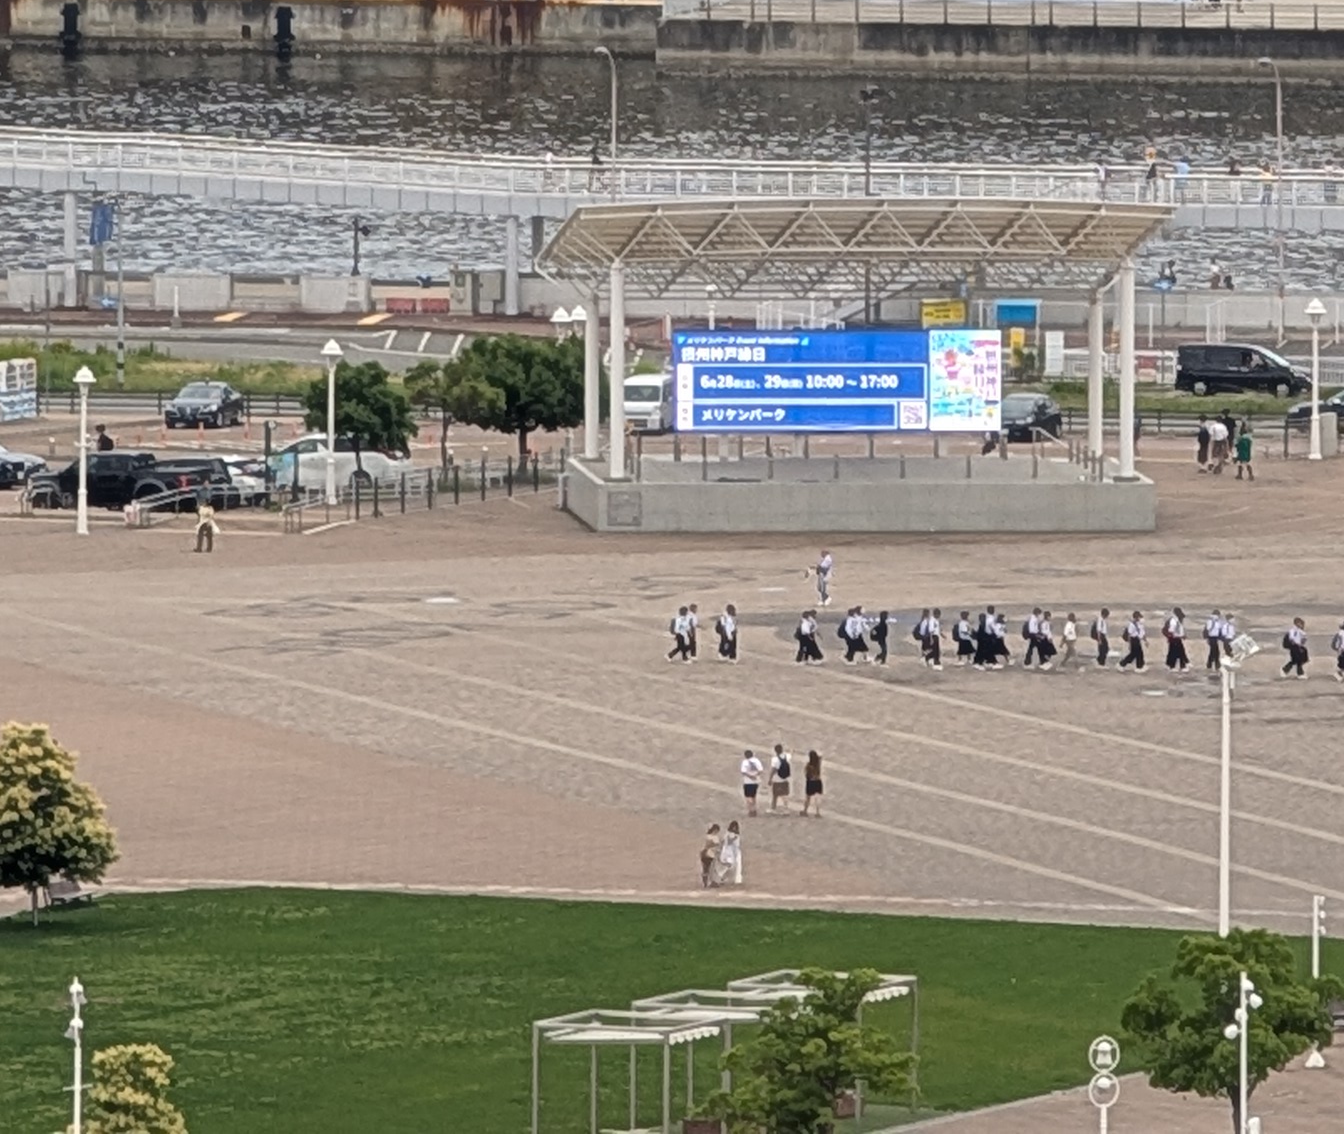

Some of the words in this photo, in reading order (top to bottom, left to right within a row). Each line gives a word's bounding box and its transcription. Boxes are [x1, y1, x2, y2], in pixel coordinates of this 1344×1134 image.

[806, 374, 844, 389] 10:00
[859, 374, 899, 389] 17:00
[701, 407, 786, 422] メリケンパーク
